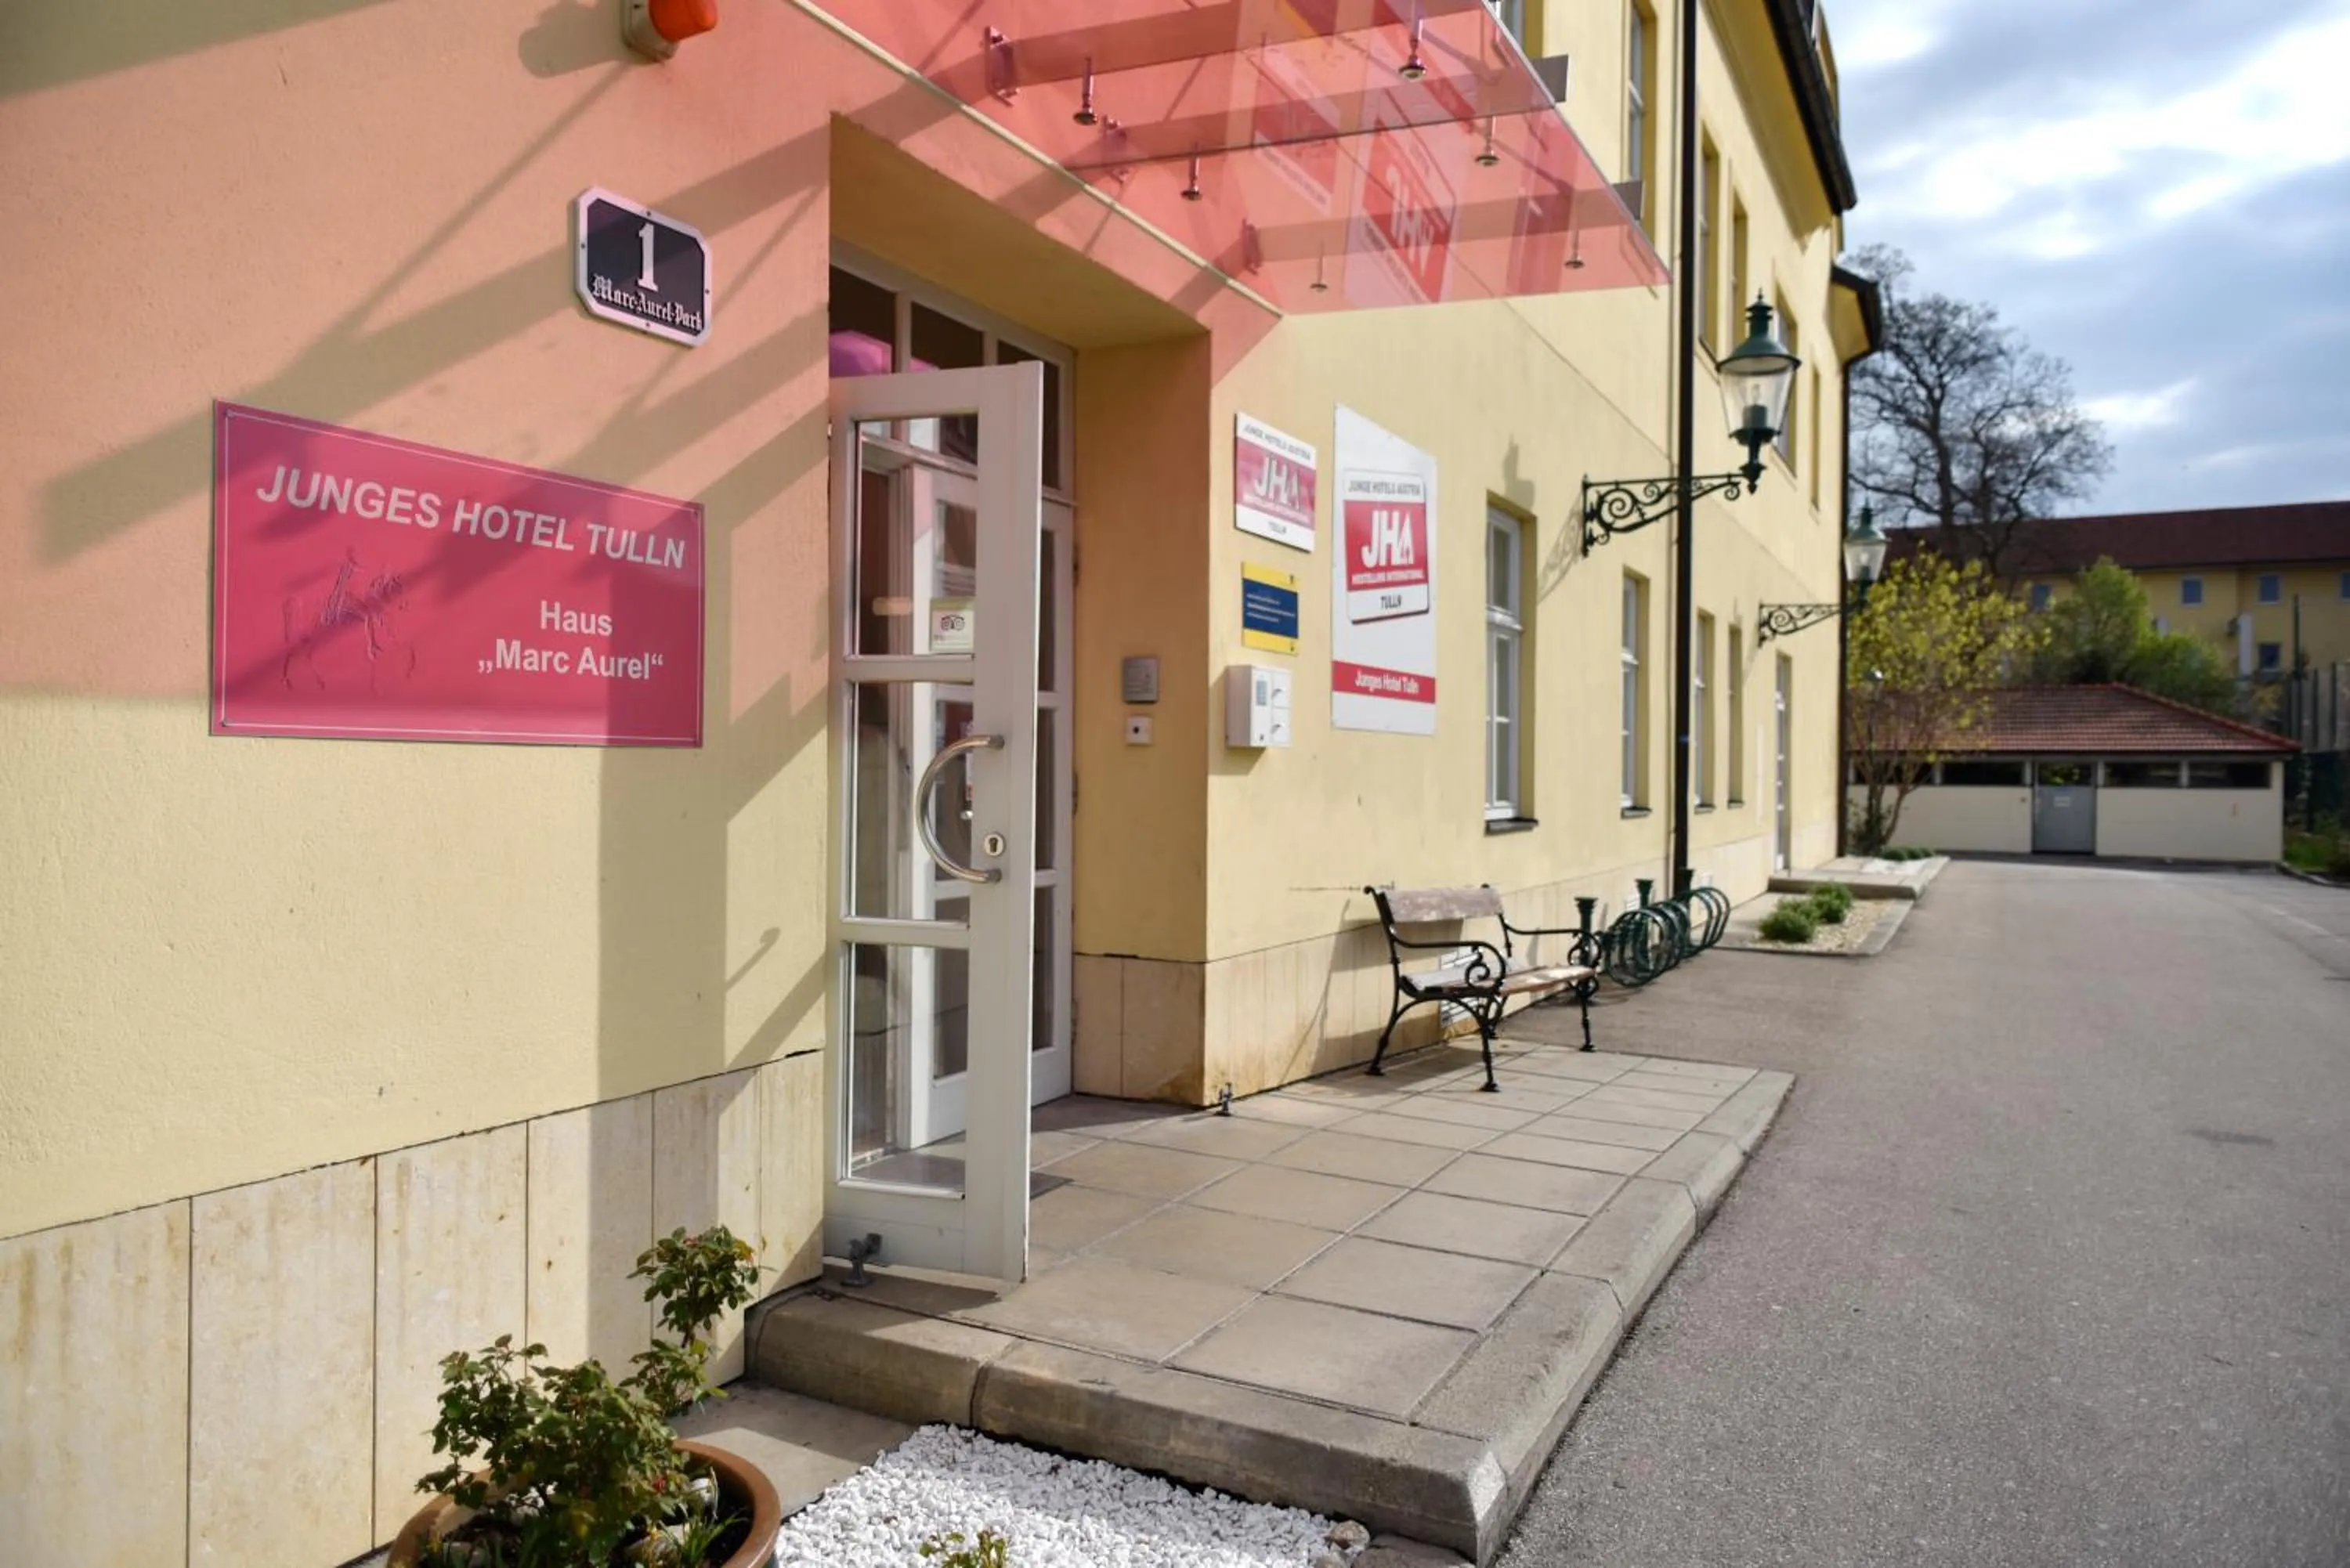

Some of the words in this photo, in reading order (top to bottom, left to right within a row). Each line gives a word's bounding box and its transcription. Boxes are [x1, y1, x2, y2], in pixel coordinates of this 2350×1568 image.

[638, 222, 659, 292] 1
[1253, 455, 1300, 510] JHA
[256, 465, 443, 529] JUNGES
[452, 499, 574, 551] HOTEL
[586, 523, 685, 569] TULLN
[1361, 509, 1414, 569] JHA
[540, 600, 613, 637] Haus
[478, 638, 569, 674] „Marc
[1354, 670, 1382, 693] Junges
[1383, 674, 1401, 692] Hotel
[1402, 676, 1419, 694] Tulln
